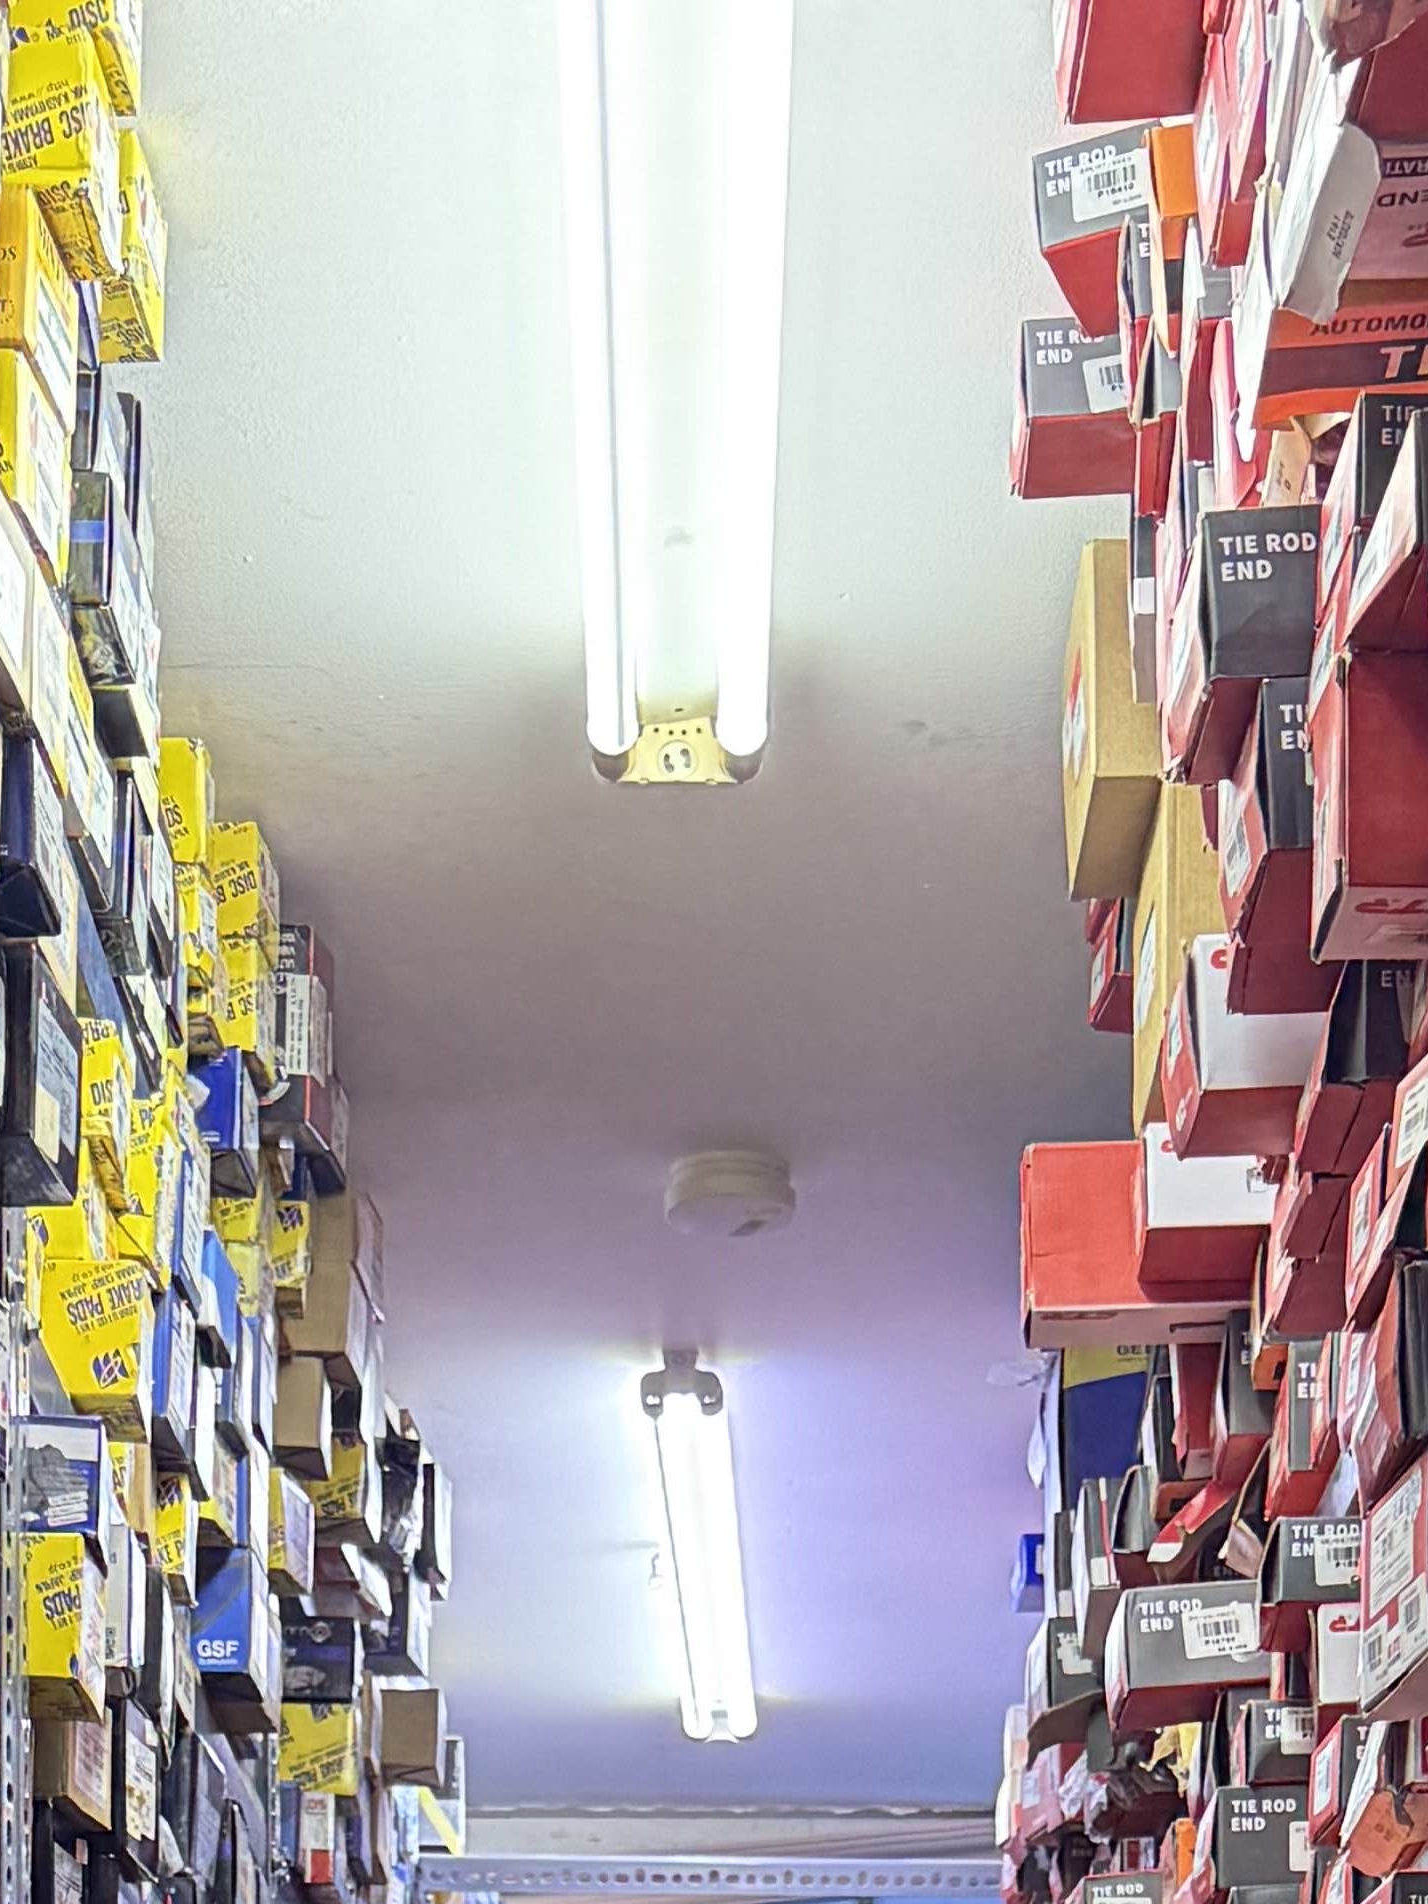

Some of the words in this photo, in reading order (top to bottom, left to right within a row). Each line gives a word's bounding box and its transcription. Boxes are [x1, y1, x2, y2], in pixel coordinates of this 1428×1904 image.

[1045, 159, 1073, 178] TIE
[1035, 331, 1065, 346] TIE
[1036, 349, 1073, 366] END
[1218, 535, 1259, 556] TIE
[1266, 532, 1316, 552] ROD
[1220, 561, 1273, 581] END
[1292, 1524, 1324, 1540] TIE
[1139, 1601, 1169, 1616] TIE
[1139, 1616, 1174, 1633] END
[197, 1639, 239, 1658] GSF
[1231, 1799, 1261, 1814] TIE
[1264, 1797, 1297, 1813] ROD
[1231, 1817, 1266, 1832] END
[1092, 1885, 1114, 1897] TIE
[1117, 1884, 1144, 1895] ROD
